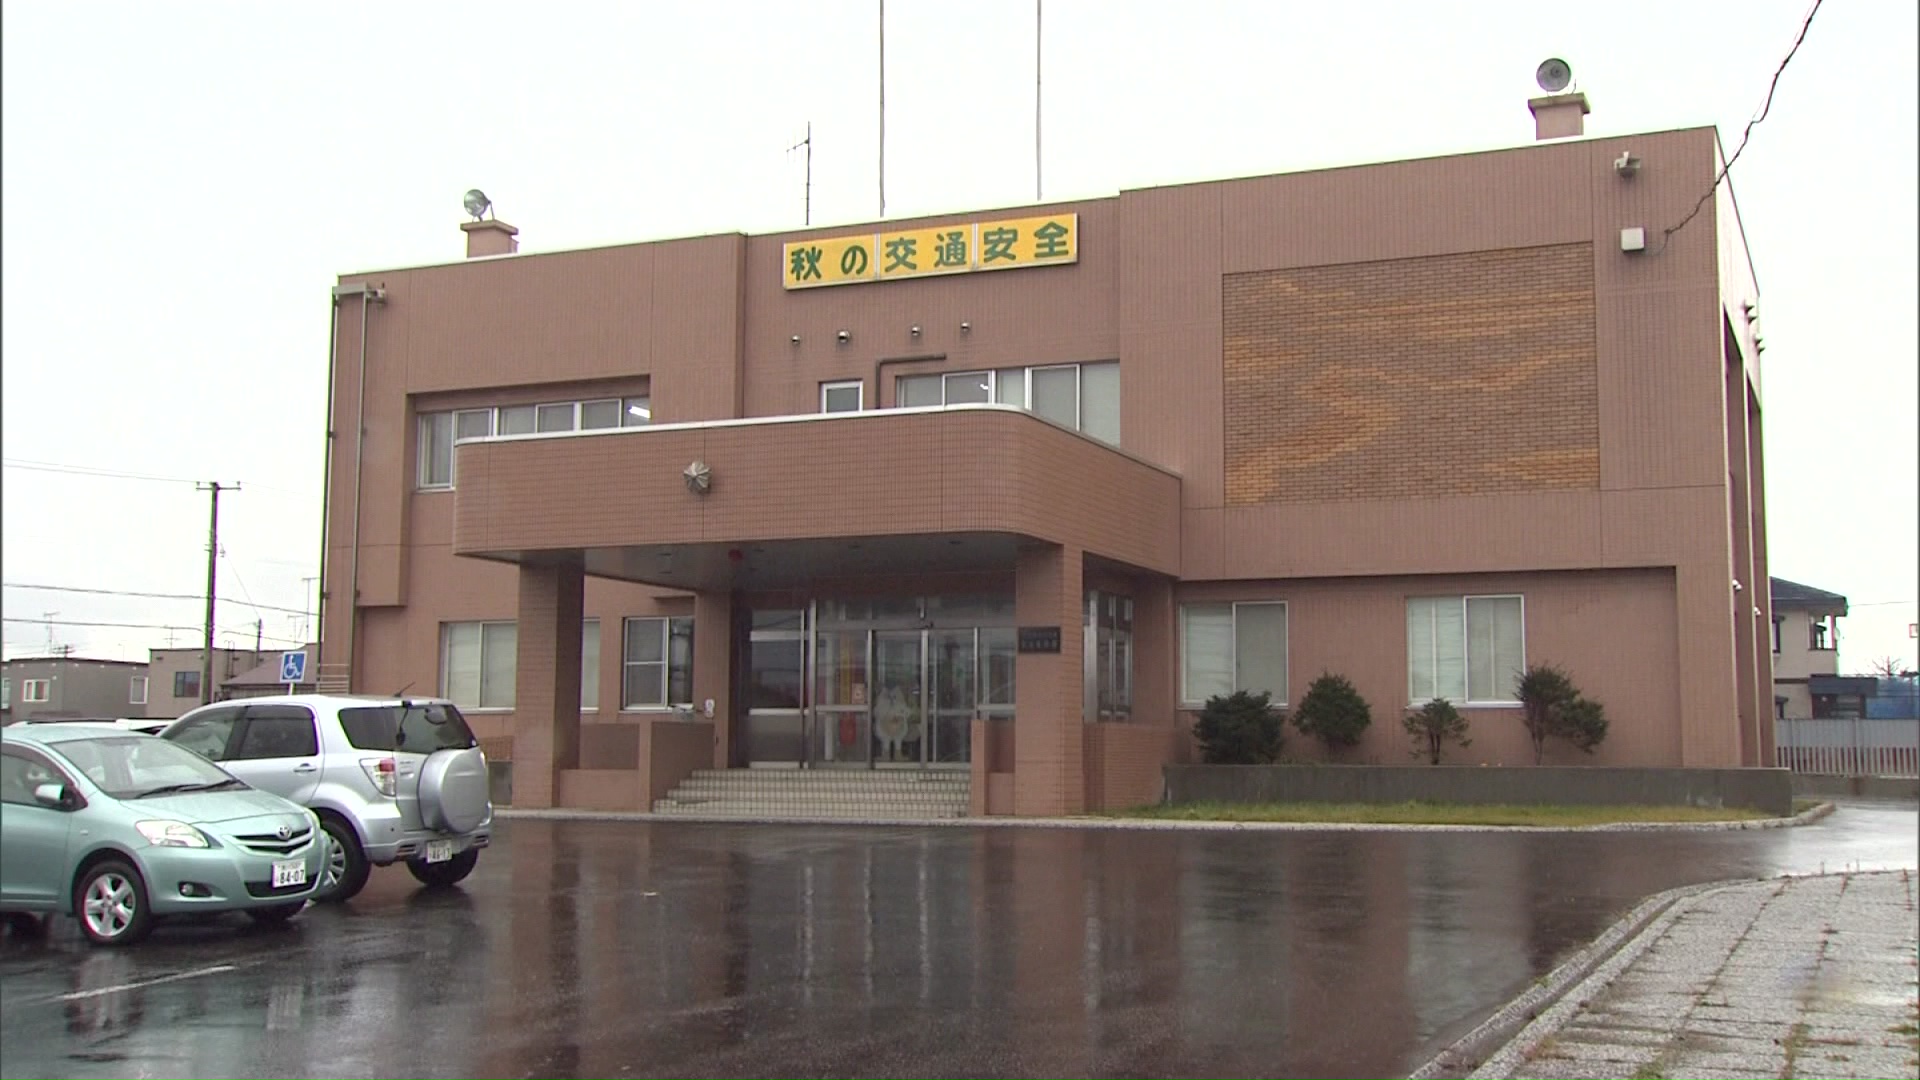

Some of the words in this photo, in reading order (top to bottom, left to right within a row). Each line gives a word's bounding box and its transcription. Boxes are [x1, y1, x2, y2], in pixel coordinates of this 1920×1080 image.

[790, 221, 1069, 281] 秋の交通安全
[280, 869, 304, 884] 84-07
